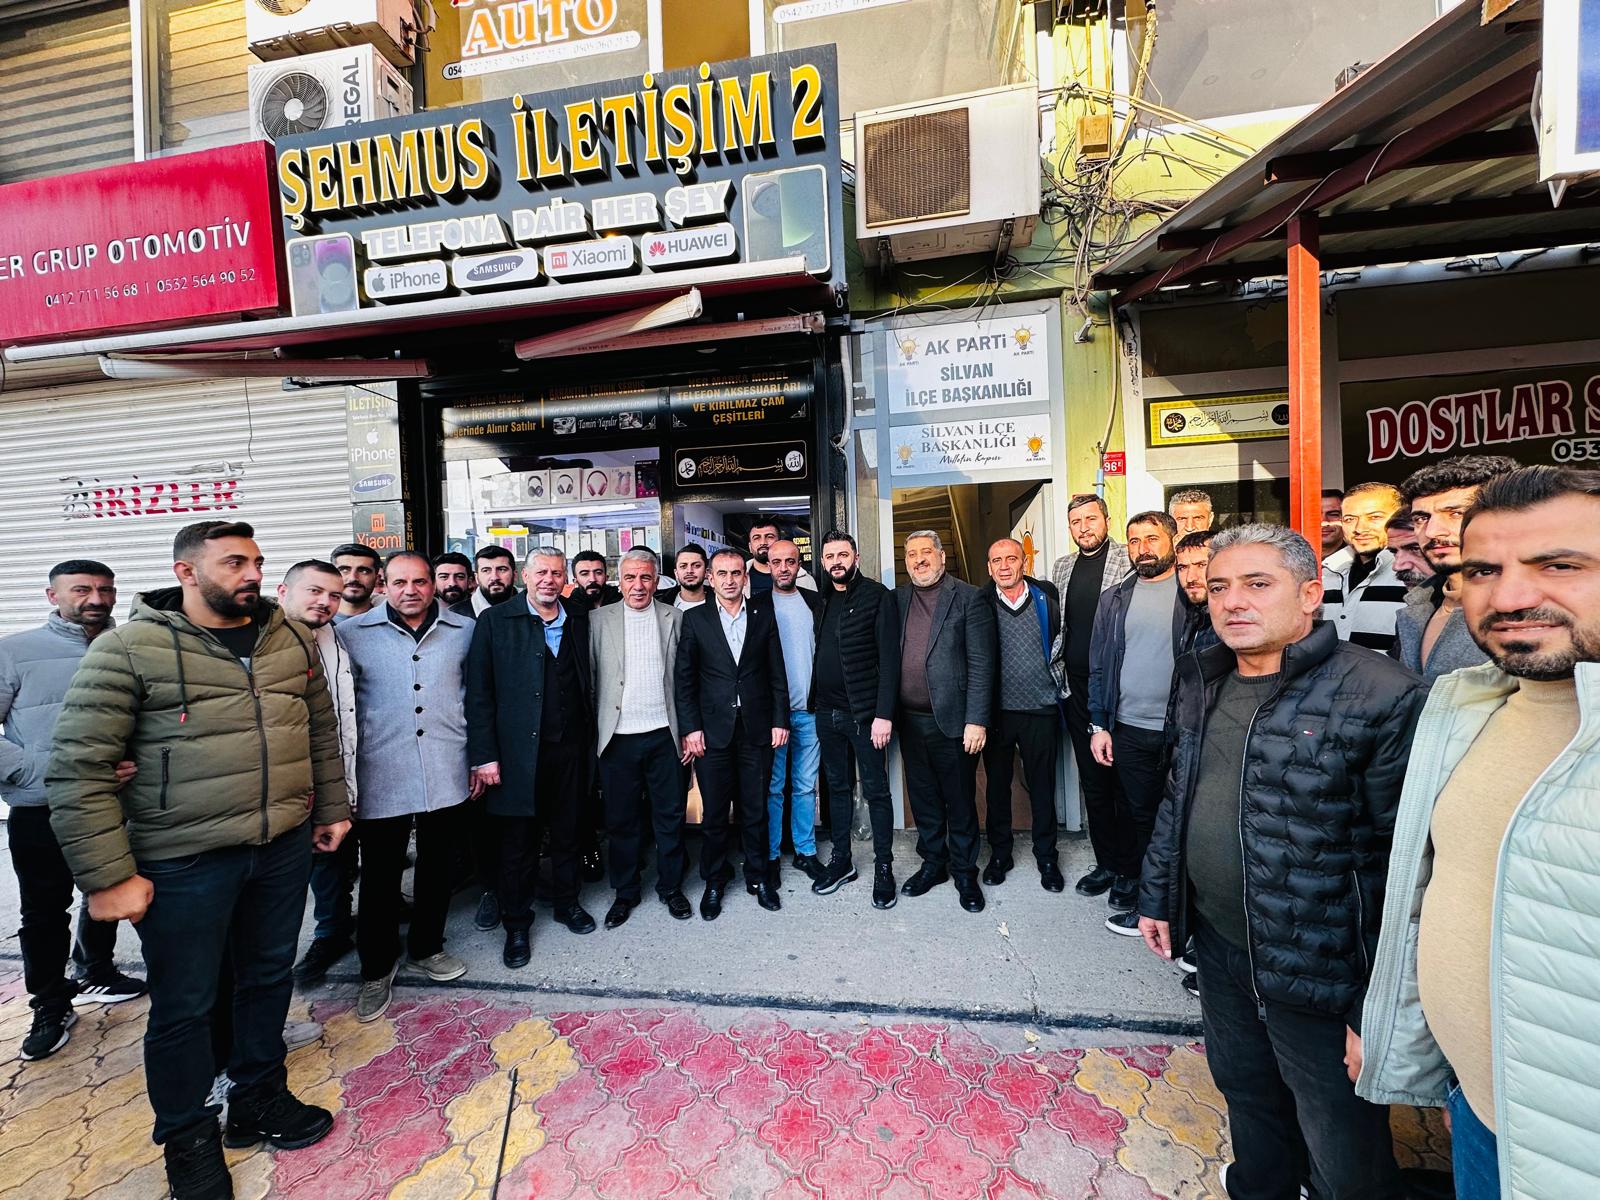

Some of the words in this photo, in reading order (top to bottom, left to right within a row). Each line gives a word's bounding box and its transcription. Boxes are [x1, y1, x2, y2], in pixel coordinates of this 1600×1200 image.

[461, 0, 618, 57] AUTO
[277, 118, 490, 230] ŞEHMUS
[511, 61, 775, 182] İLETİŞİM
[790, 64, 825, 141] 2
[361, 213, 508, 261] TELEFONA
[512, 196, 586, 242] DAİR
[591, 192, 661, 231] HER
[664, 180, 733, 225] ŞEY
[32, 243, 98, 275] GRUP
[107, 216, 251, 265] OTOMOTİV
[668, 233, 728, 254] HUAWEI
[571, 244, 628, 266] Xiaomi
[473, 261, 518, 276] SAMSUNG
[45, 291, 75, 308] 0412
[79, 287, 99, 302] 711
[104, 286, 119, 299] 56
[123, 283, 138, 297] 68
[157, 276, 187, 293] 0532
[192, 273, 215, 288] 564
[220, 270, 236, 284] 90
[240, 268, 256, 282] 52
[389, 271, 441, 290] iPhone
[924, 338, 950, 356] AK
[940, 362, 993, 382] SİLVAN
[677, 388, 721, 401] TELEFON
[723, 382, 801, 397] AKSESUARLARI
[905, 388, 937, 408] İLÇE
[943, 378, 1032, 404] BAŞKANLIĞI
[692, 402, 706, 412] VE
[709, 398, 758, 411] KIRILMAZ
[761, 396, 785, 407] CAM
[712, 408, 765, 424] ÇEŞİTLERİ
[1366, 380, 1576, 464] DOSTLAR
[487, 423, 509, 435] Alınır
[511, 420, 537, 432] Satılır
[921, 424, 974, 439] SİLVAN
[979, 421, 1015, 436] İLÇE
[921, 434, 1017, 454] BAŞKANLIĞI
[351, 448, 396, 462] iPhone
[358, 478, 392, 488] SAMSUNG
[356, 532, 402, 549] Xiaomi
